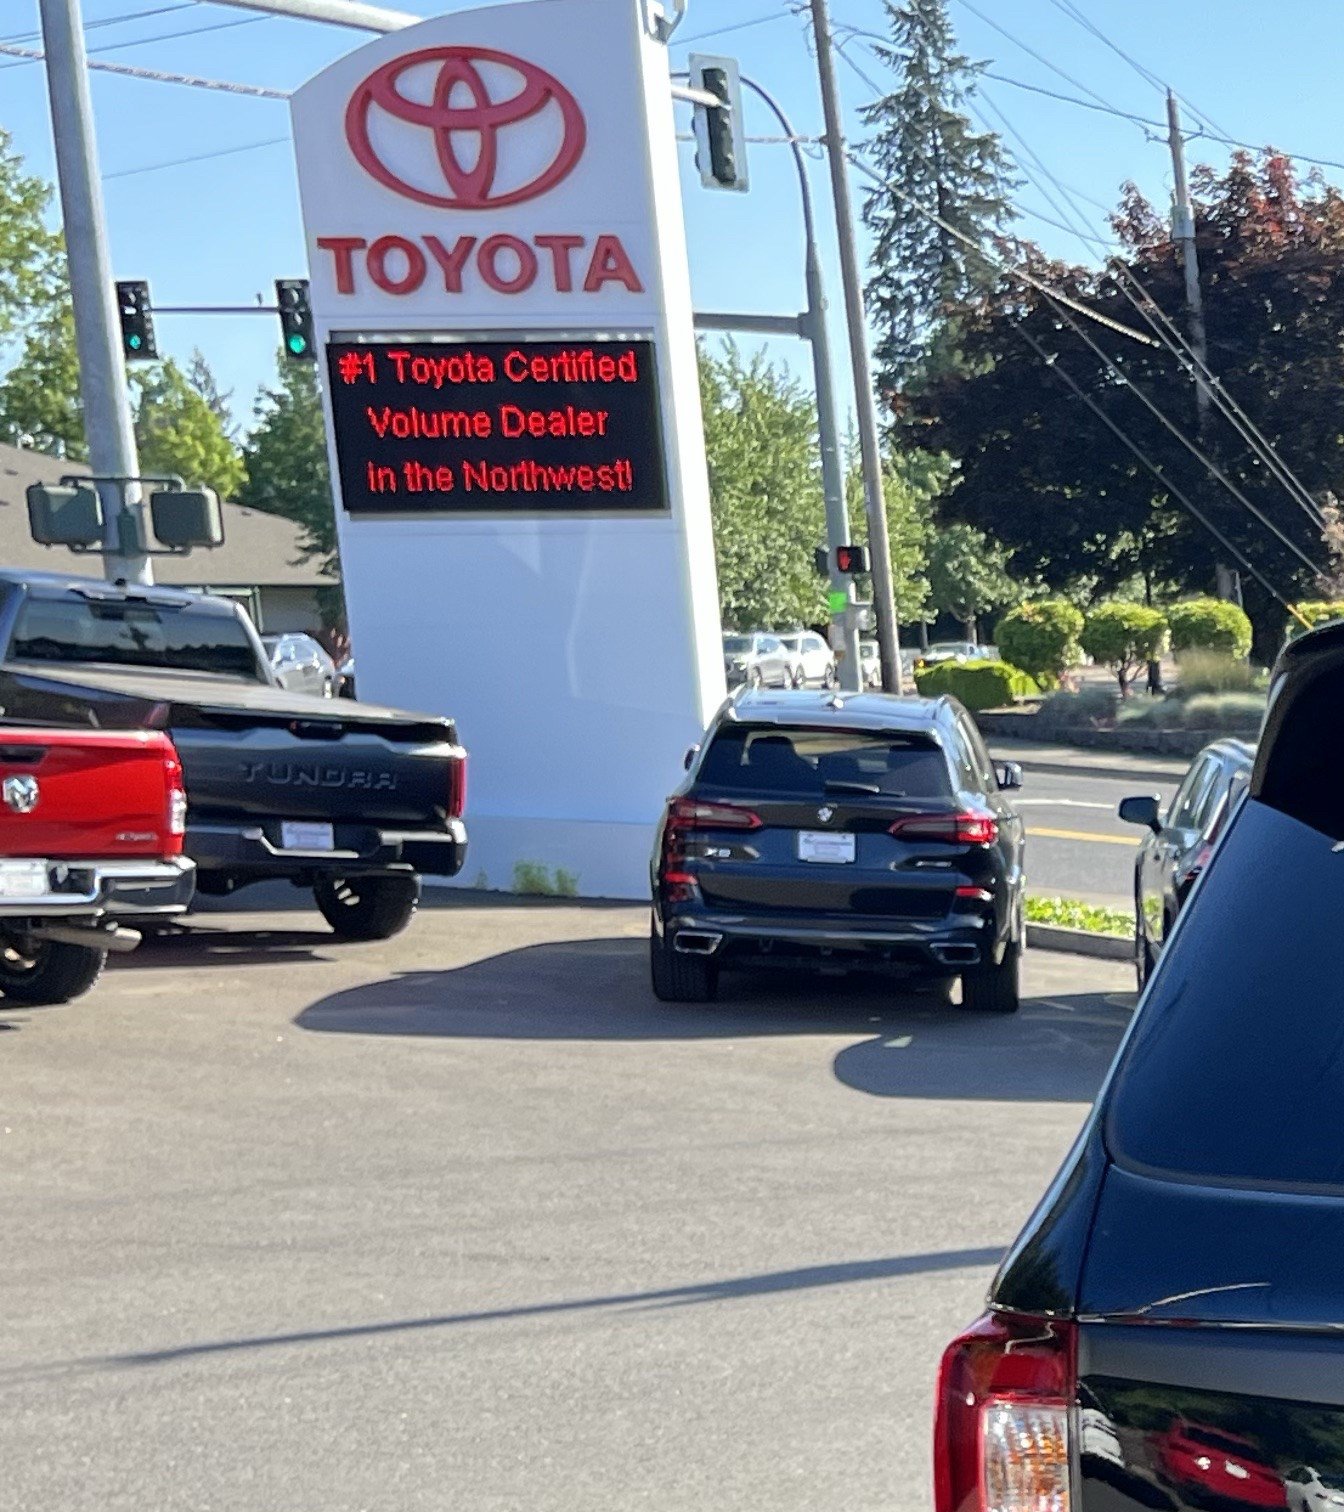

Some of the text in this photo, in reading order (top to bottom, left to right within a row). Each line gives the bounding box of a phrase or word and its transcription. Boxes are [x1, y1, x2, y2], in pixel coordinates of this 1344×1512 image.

[316, 234, 645, 295] TOYOTA
[338, 349, 638, 389] #1 Toyota Certified
[366, 404, 609, 438] Volume Dealer
[367, 459, 633, 493] In the Northwest!
[239, 761, 397, 790] TUNDRA
